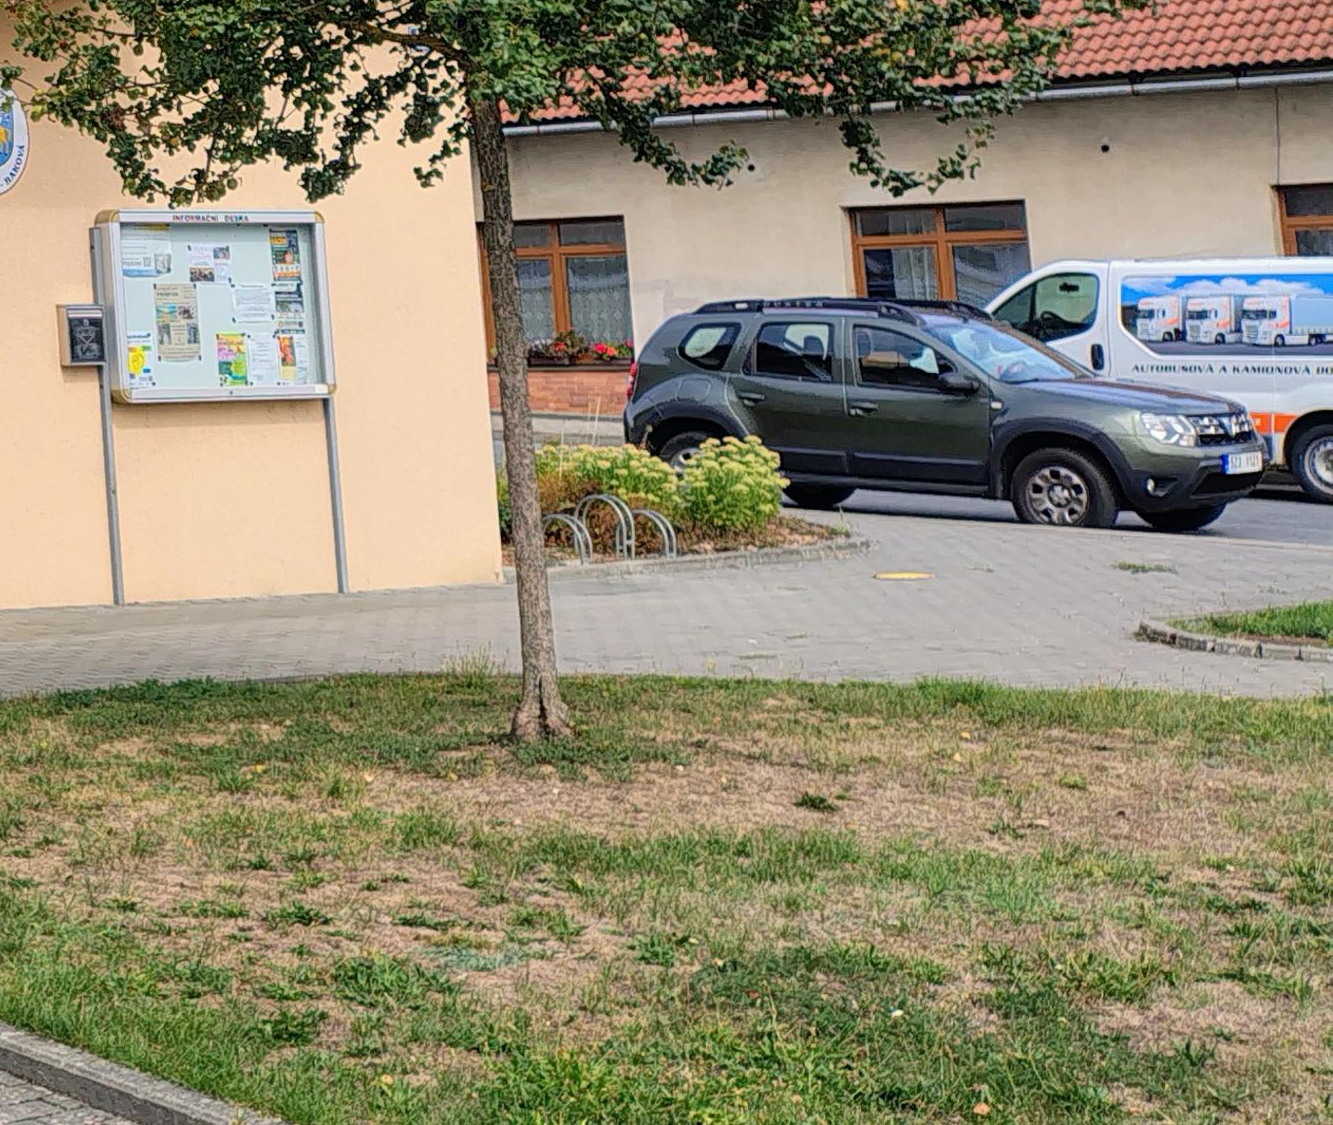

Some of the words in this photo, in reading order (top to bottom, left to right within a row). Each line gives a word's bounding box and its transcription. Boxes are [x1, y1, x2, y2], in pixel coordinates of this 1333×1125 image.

[1133, 363, 1214, 374] AUTOBUSOVÁ
[1219, 364, 1227, 374] A
[1233, 363, 1311, 374] KAMIONOVÁ
